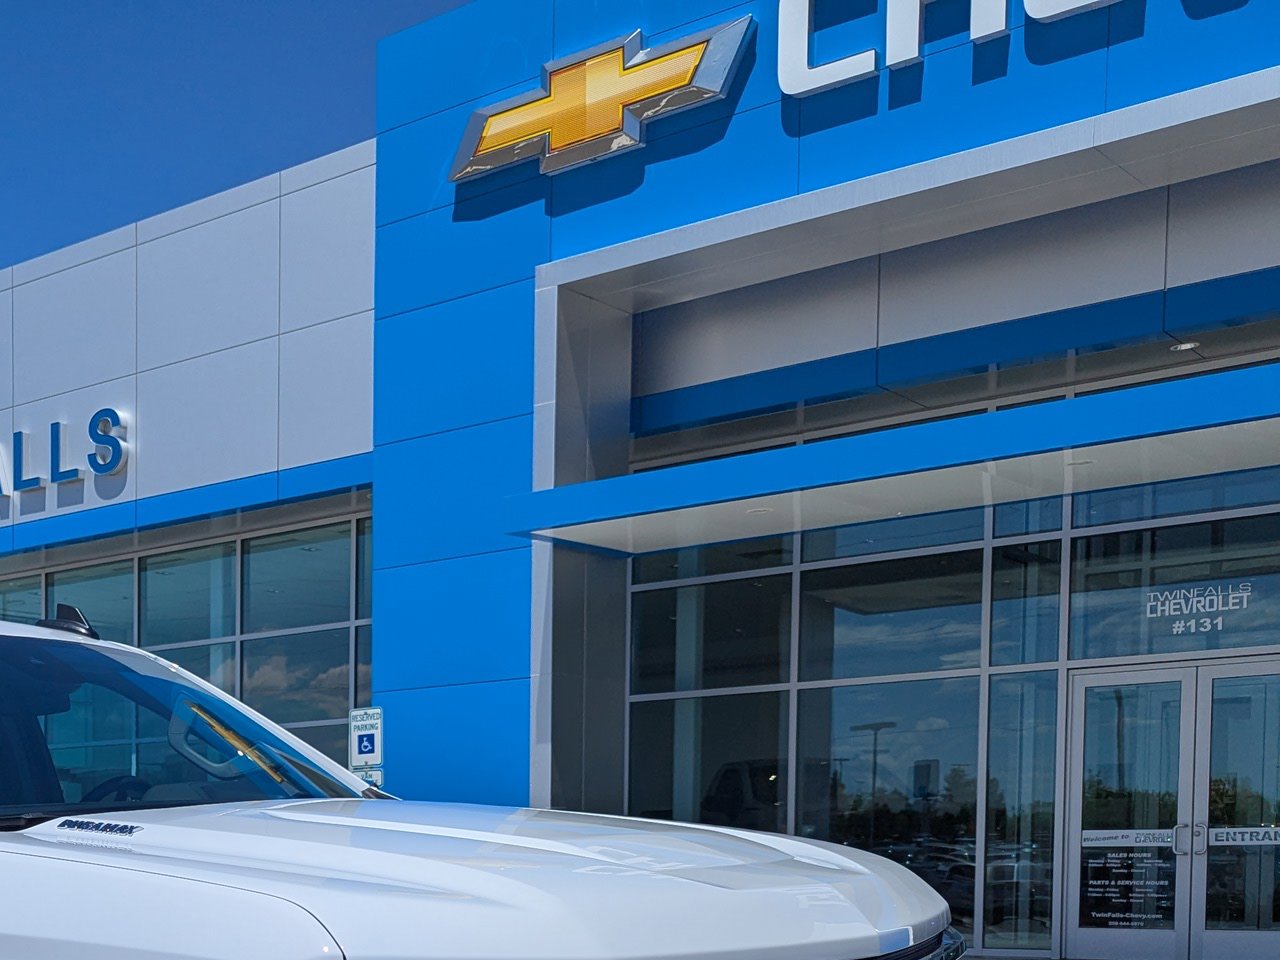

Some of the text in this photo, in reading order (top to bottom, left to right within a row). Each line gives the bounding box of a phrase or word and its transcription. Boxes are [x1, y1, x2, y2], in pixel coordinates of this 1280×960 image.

[1146, 583, 1252, 602] TWINFALLS
[1146, 592, 1252, 618] CHEVROLET
[1172, 616, 1223, 635] #131
[351, 712, 381, 723] RESERVED
[353, 723, 379, 733] PARKING
[1083, 834, 1119, 843] Welcome
